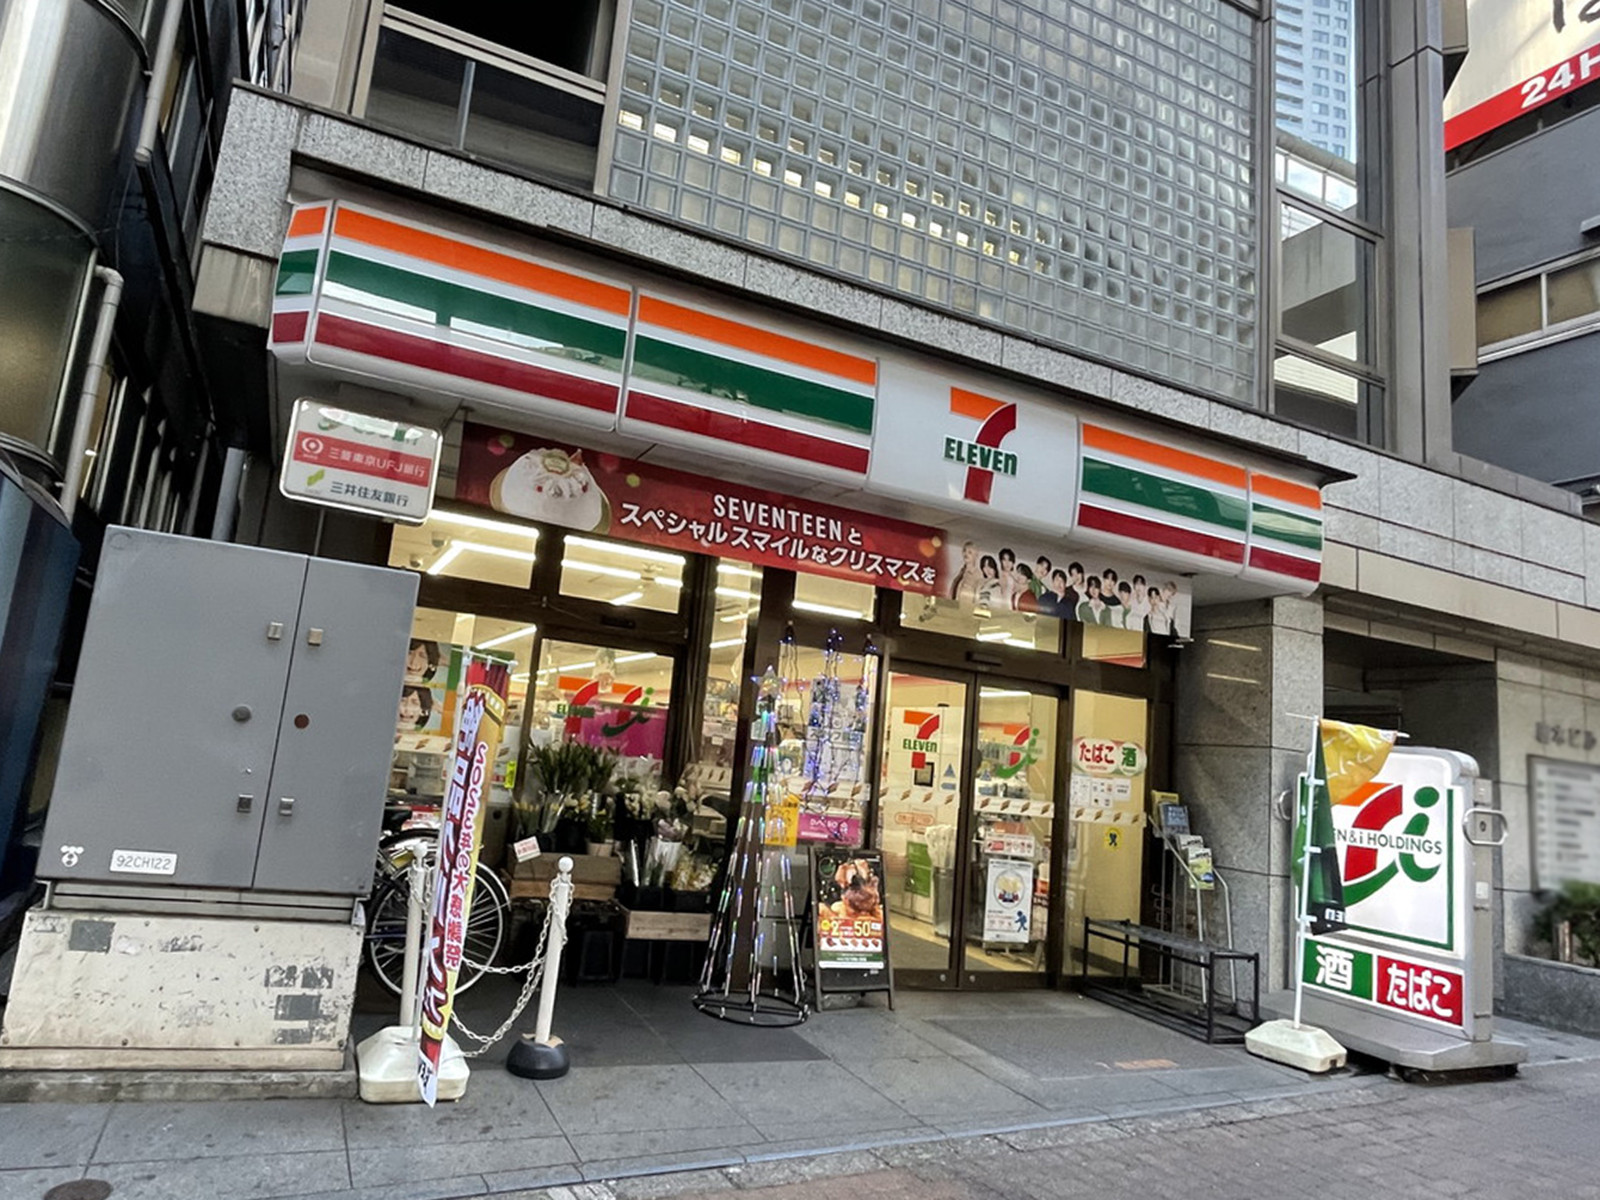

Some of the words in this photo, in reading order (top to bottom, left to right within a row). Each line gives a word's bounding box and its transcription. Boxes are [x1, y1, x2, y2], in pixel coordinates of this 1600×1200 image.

[328, 447, 426, 478] 三菱東京UFJ銀行
[330, 481, 410, 508] 三井住友銀行
[713, 494, 842, 542] SEVENTEEN
[620, 503, 937, 585] スペシャルスマイルなクリスマスを
[1079, 742, 1115, 765] たばこ
[1121, 746, 1137, 767] 酒
[1368, 832, 1443, 855] HOLDINGS
[116, 854, 172, 870] 92CH122
[1315, 945, 1355, 991] 酒
[1386, 962, 1454, 1017] たばこ
